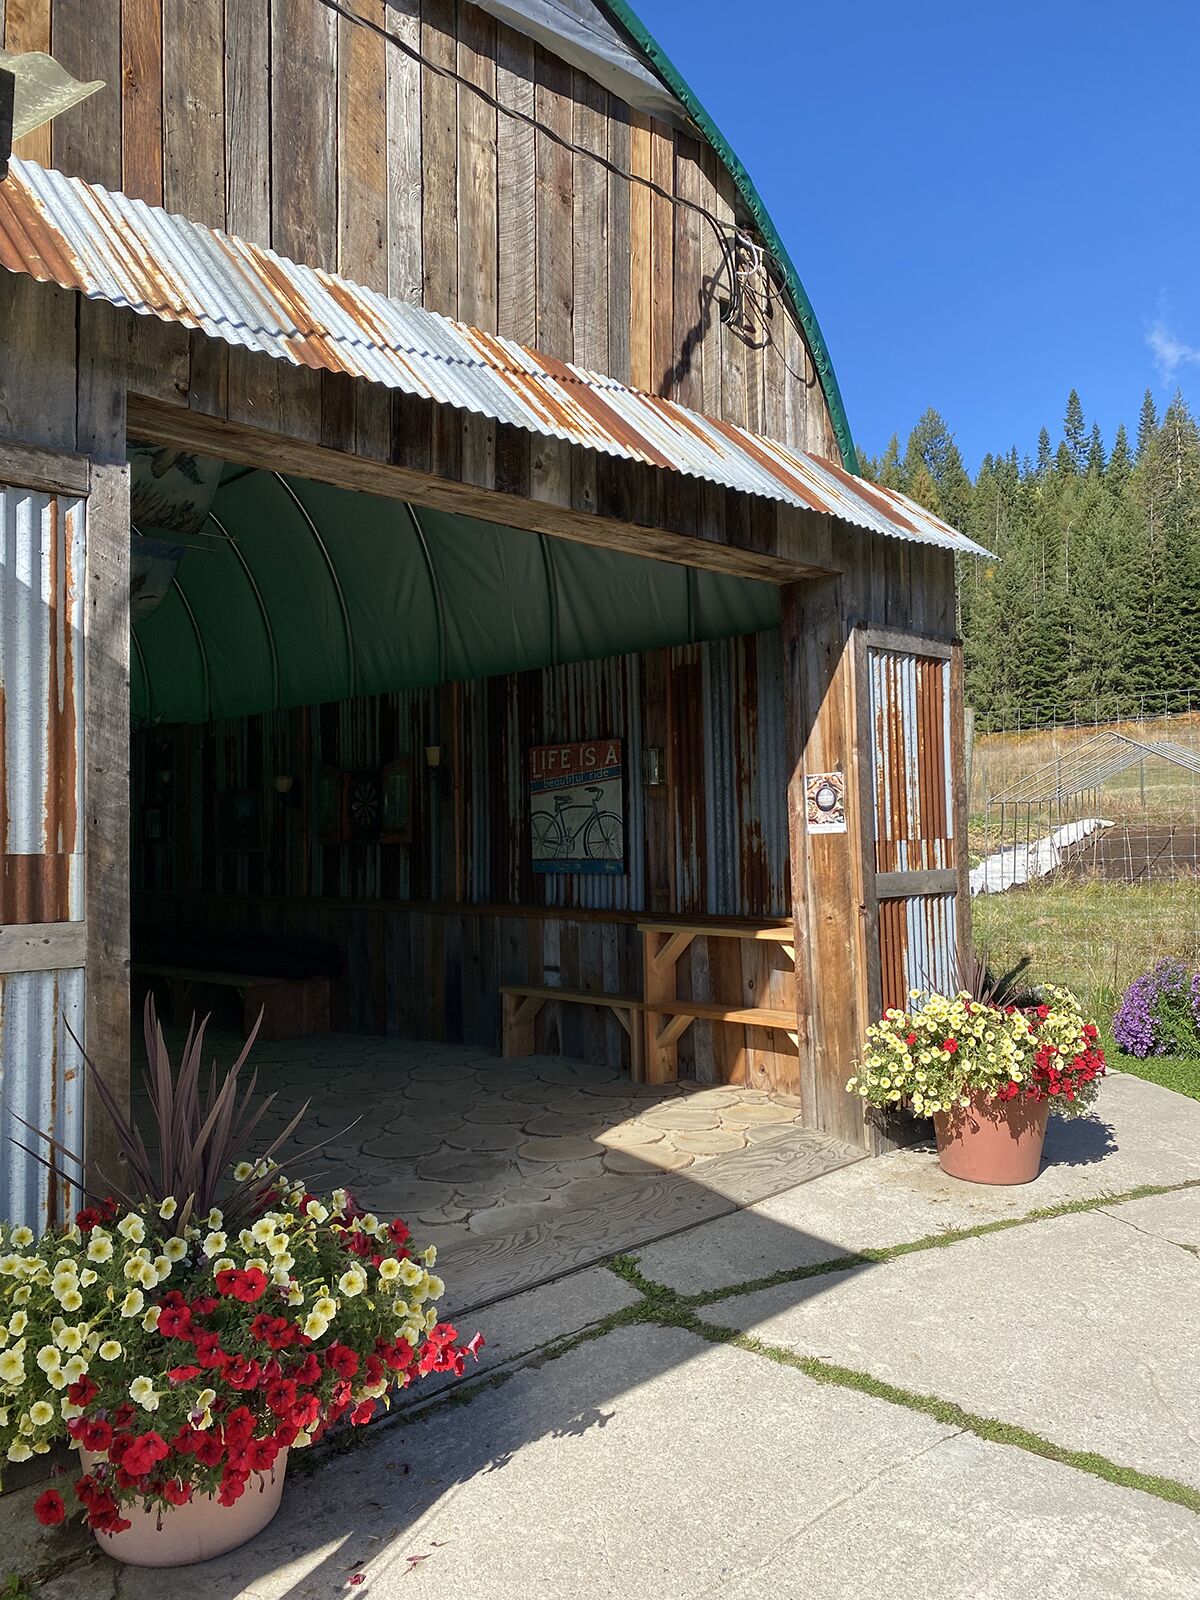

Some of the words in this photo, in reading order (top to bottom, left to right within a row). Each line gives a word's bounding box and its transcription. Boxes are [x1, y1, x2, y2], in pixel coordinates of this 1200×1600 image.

[532, 748, 571, 778] LIFE
[580, 747, 596, 766] IS
[605, 745, 618, 765] A
[543, 773, 584, 788] beautiful
[589, 768, 609, 780] ride
